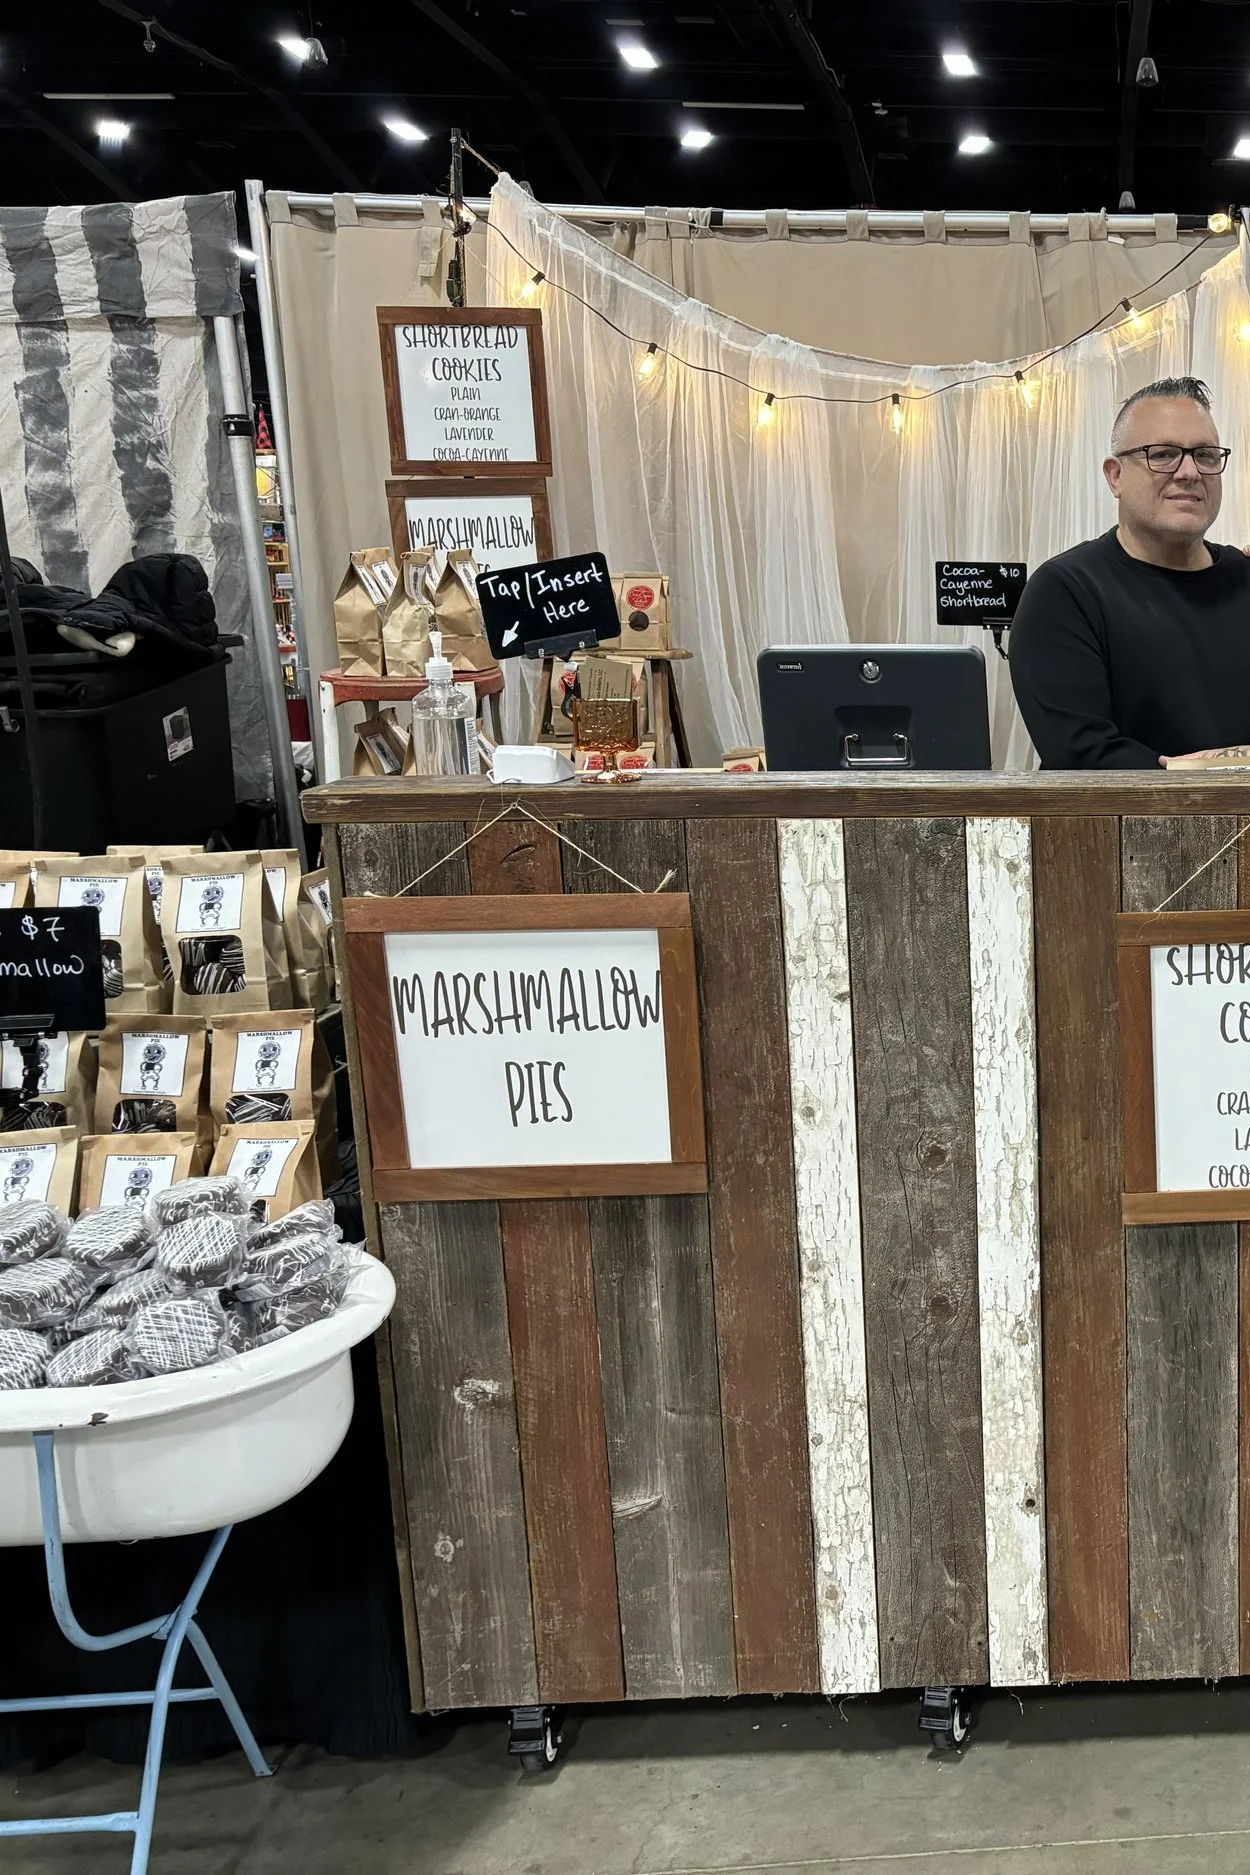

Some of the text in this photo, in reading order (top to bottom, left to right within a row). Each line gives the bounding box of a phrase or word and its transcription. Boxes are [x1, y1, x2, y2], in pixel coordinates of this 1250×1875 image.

[402, 325, 519, 350] SHORTBREAD
[432, 357, 502, 382] COOKIES
[450, 387, 481, 402] PLAIN
[434, 407, 501, 421] CRAN-ORANGE
[444, 427, 494, 441] LAVENDER
[433, 447, 509, 462] COCOA-CAYENNE
[409, 515, 535, 551] MARSHMALLOW
[943, 564, 1020, 578] Cocoa- $10
[480, 561, 603, 609] Tap/Insert
[940, 578, 993, 596] Cayenne
[543, 598, 590, 624] Here
[940, 593, 1006, 608] Shortbread
[393, 966, 660, 1038] MARSHMALLOW
[505, 1060, 573, 1127] PIES
